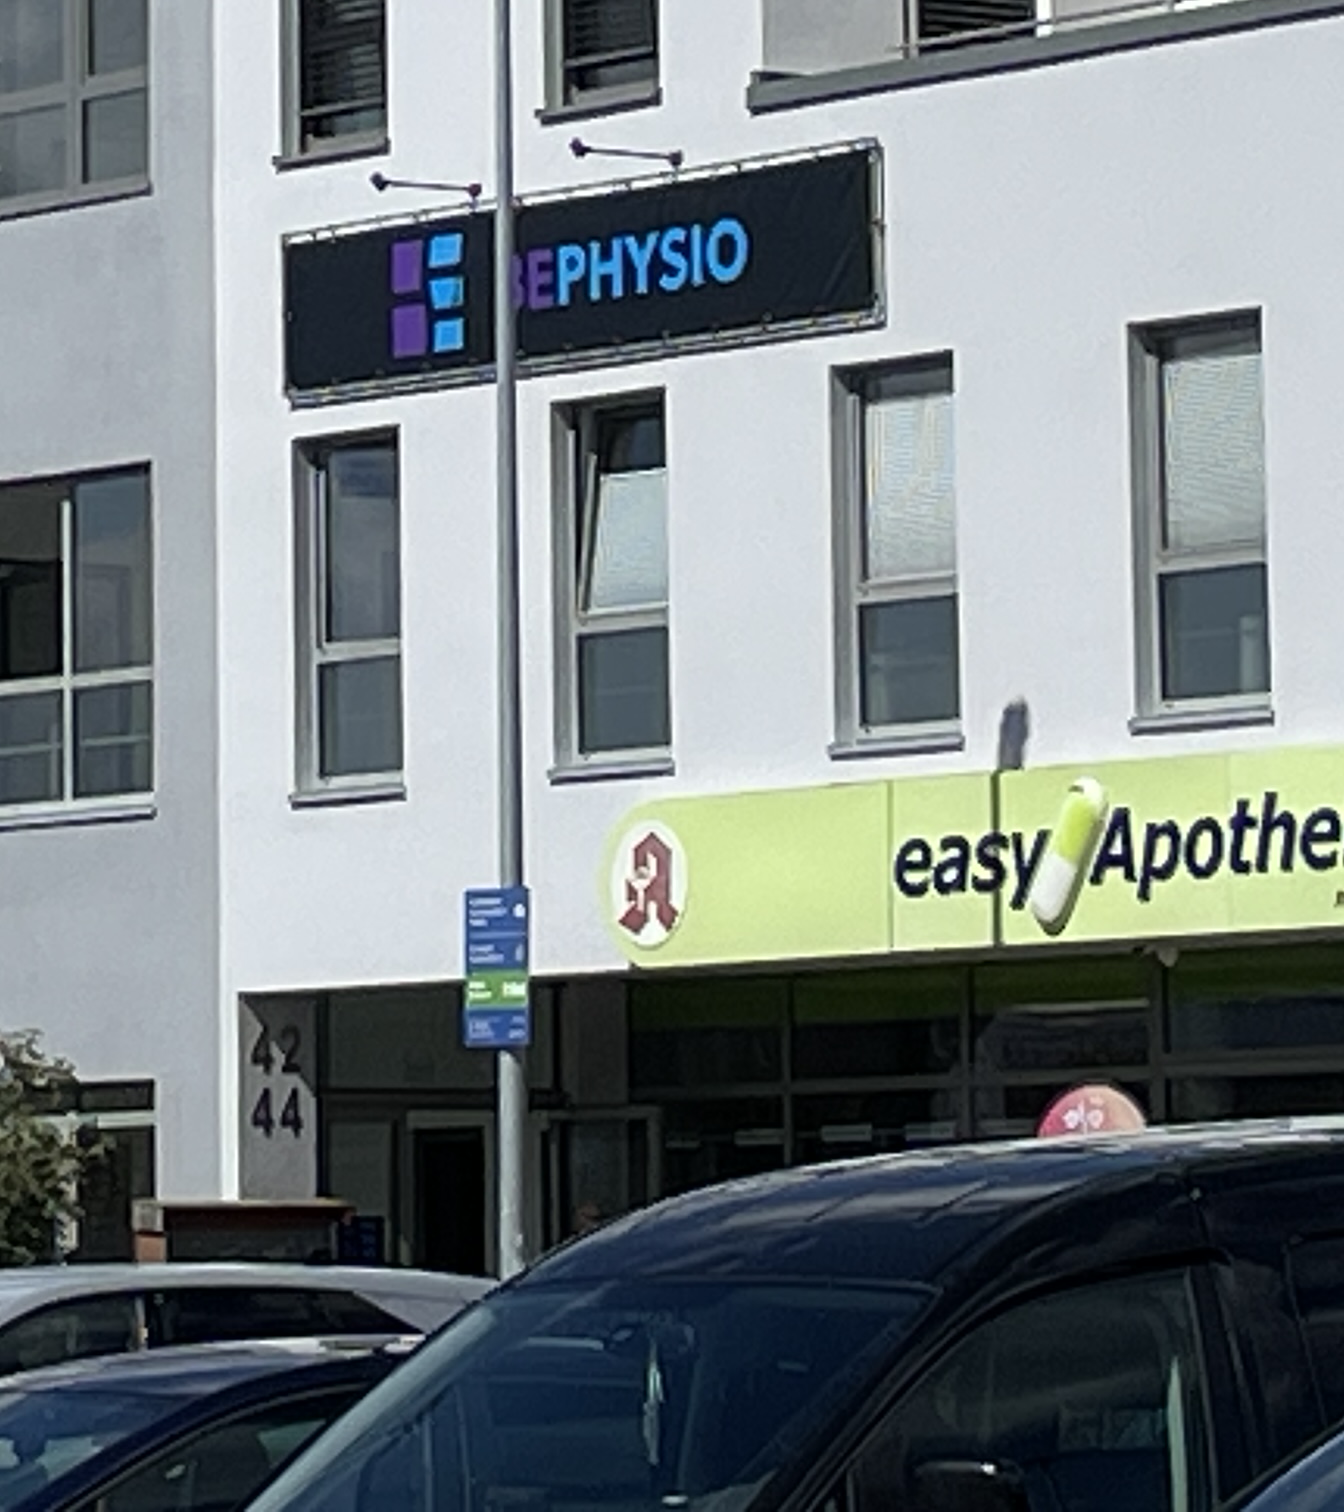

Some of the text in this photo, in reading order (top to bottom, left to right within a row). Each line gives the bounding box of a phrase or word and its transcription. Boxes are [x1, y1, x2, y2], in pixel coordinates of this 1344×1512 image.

[894, 828, 1051, 910] easy
[251, 1024, 302, 1075] 42
[251, 1086, 303, 1138] 44
